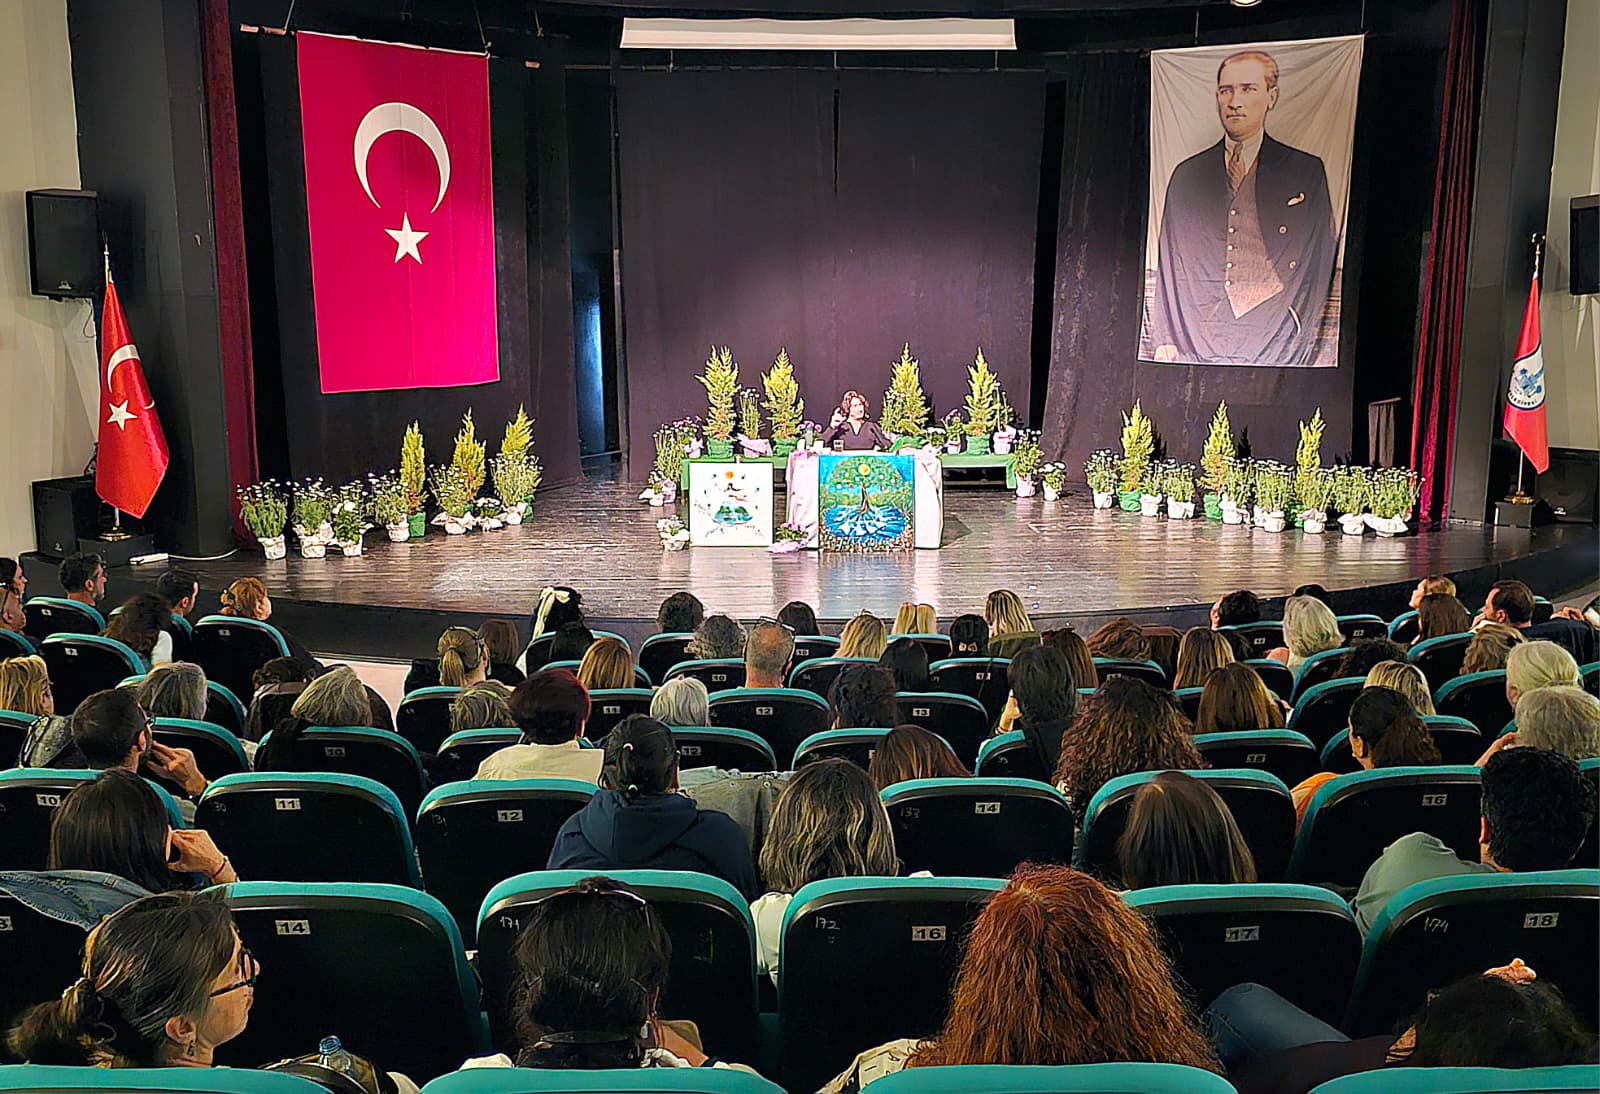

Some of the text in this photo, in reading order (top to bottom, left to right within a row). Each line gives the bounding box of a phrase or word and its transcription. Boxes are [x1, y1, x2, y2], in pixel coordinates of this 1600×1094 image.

[713, 674, 727, 682] 10
[604, 706, 620, 714] 11
[757, 707, 773, 715] 12
[39, 795, 59, 805] 10
[278, 799, 297, 810] 11
[1425, 795, 1446, 805] 16
[977, 803, 999, 813] 14
[500, 811, 521, 822] 12
[499, 916, 520, 931] 171
[815, 916, 841, 930] 172
[1425, 917, 1449, 933] 174
[1527, 914, 1555, 927] 18
[279, 921, 307, 934] 14
[915, 927, 943, 940] 16
[1229, 928, 1256, 941] 17
